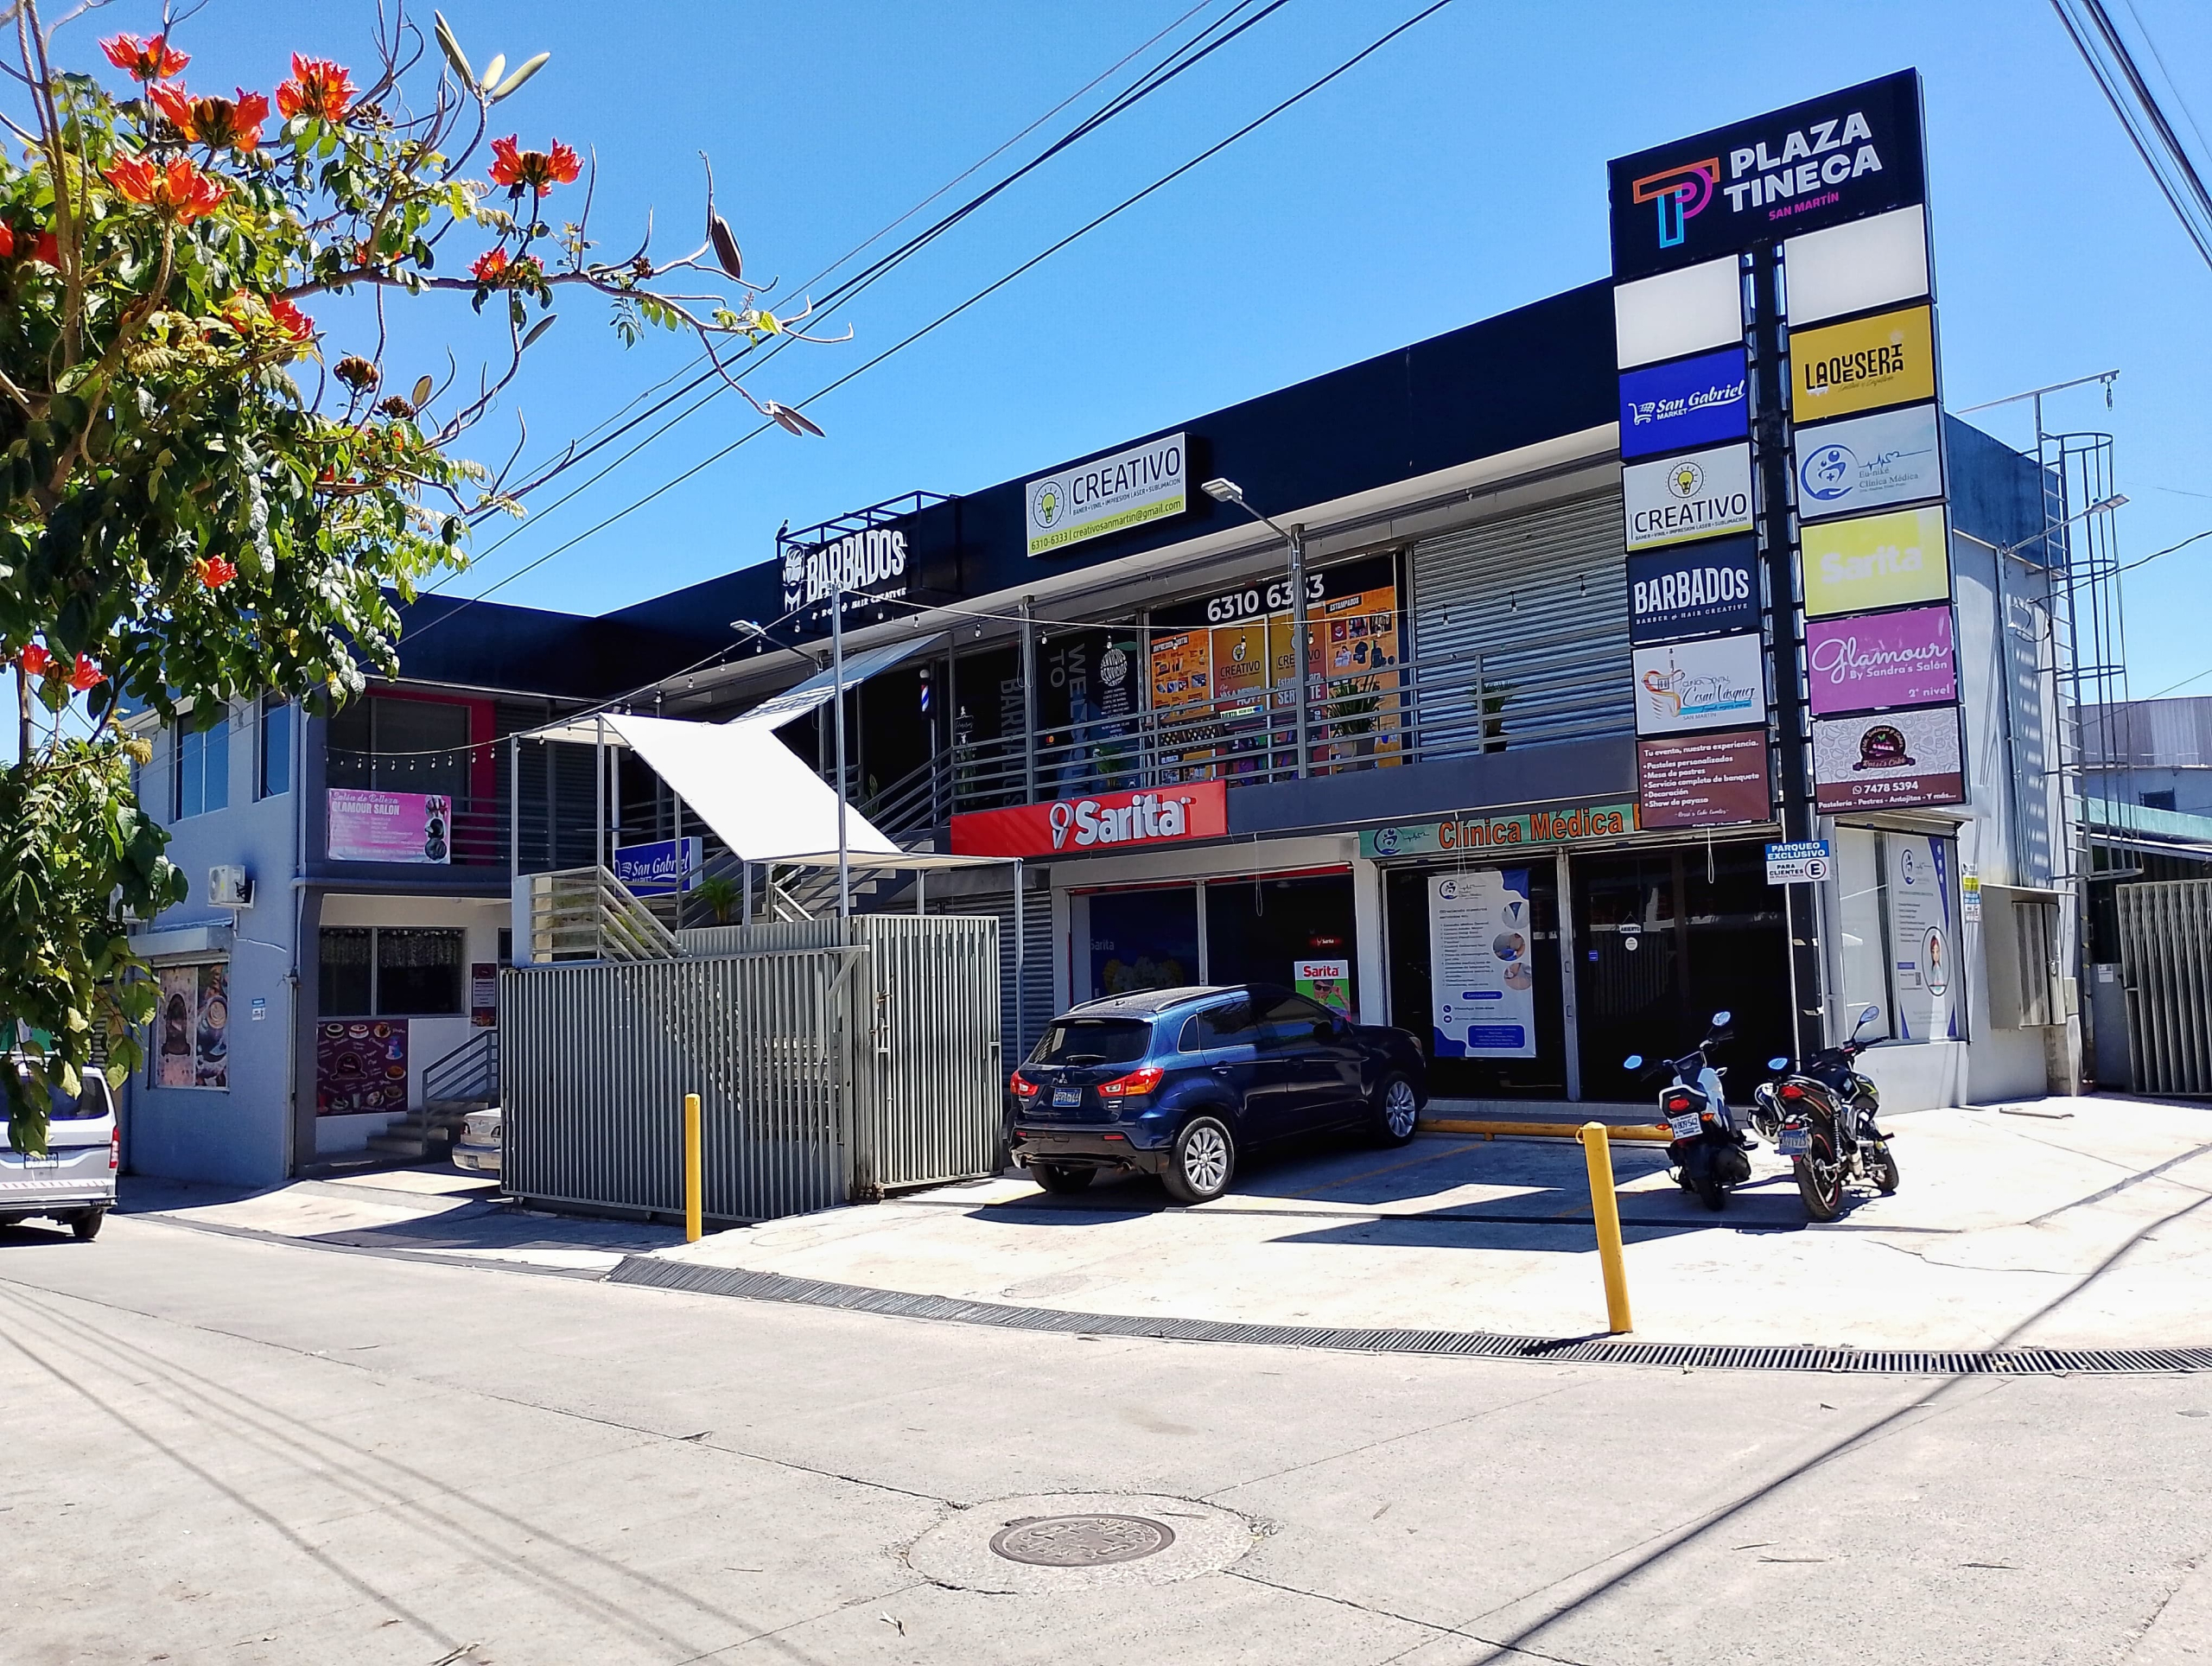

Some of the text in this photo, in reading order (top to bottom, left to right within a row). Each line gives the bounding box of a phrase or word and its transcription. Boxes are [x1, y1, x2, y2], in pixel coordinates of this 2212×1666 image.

[1729, 111, 1872, 179] PLAZA
[1723, 143, 1884, 213] TINECA
[1768, 191, 1840, 221] SAN MARTÍN
[1656, 378, 1745, 413] San Gabriel
[1656, 408, 1688, 420] MARKET
[1072, 446, 1181, 506] CREATIVO
[1859, 479, 1887, 488] Clínica
[1889, 473, 1919, 484] Médica
[1634, 492, 1748, 534] CREATIVO
[1031, 500, 1181, 551] 6310-6333 creativosanmartin@gmail.com
[806, 529, 906, 602] BARBADOS
[1820, 544, 1923, 585] Sarita
[1207, 573, 1325, 622] 6310 633
[1633, 567, 1750, 614] BARBADOS
[851, 599, 869, 609] HAIR
[1636, 614, 1669, 625] BARBER
[1681, 610, 1702, 619] HAIR
[1705, 603, 1748, 615] CREATIVE
[1050, 648, 1065, 688] TO
[1219, 659, 1261, 677] CREATIVO
[1811, 636, 1948, 684] Glamour
[1850, 659, 1948, 681] By Sandra's Salón
[1923, 684, 1950, 696] nivel
[1655, 747, 1682, 757] evento,
[1682, 745, 1712, 754] nuestra
[1713, 740, 1759, 752] experiencia.
[1647, 754, 1733, 770] Pasteles personalizados
[1647, 773, 1760, 789] Servicio completo de banquete
[1678, 768, 1706, 779] postres
[1648, 788, 1689, 798] Decoración
[1863, 780, 1919, 794] 7478 5394
[331, 800, 400, 816] GLAMOUR SALON
[1649, 799, 1670, 808] Show
[1681, 797, 1709, 807] payaso
[1818, 800, 1853, 810] Pastelería
[1858, 798, 1884, 806] Postres
[1889, 794, 1922, 804] Antojitos
[1925, 792, 1932, 801] Y
[1074, 793, 1187, 846] Sarita
[1438, 819, 1522, 850] Clínica
[1529, 806, 1624, 842] Médica
[1767, 849, 1826, 861] EXCLUSIVO
[1771, 842, 1821, 853] PARQUEO
[632, 850, 690, 877] San Gabrel
[1810, 862, 1821, 876] E
[1303, 965, 1340, 977] Sarita
